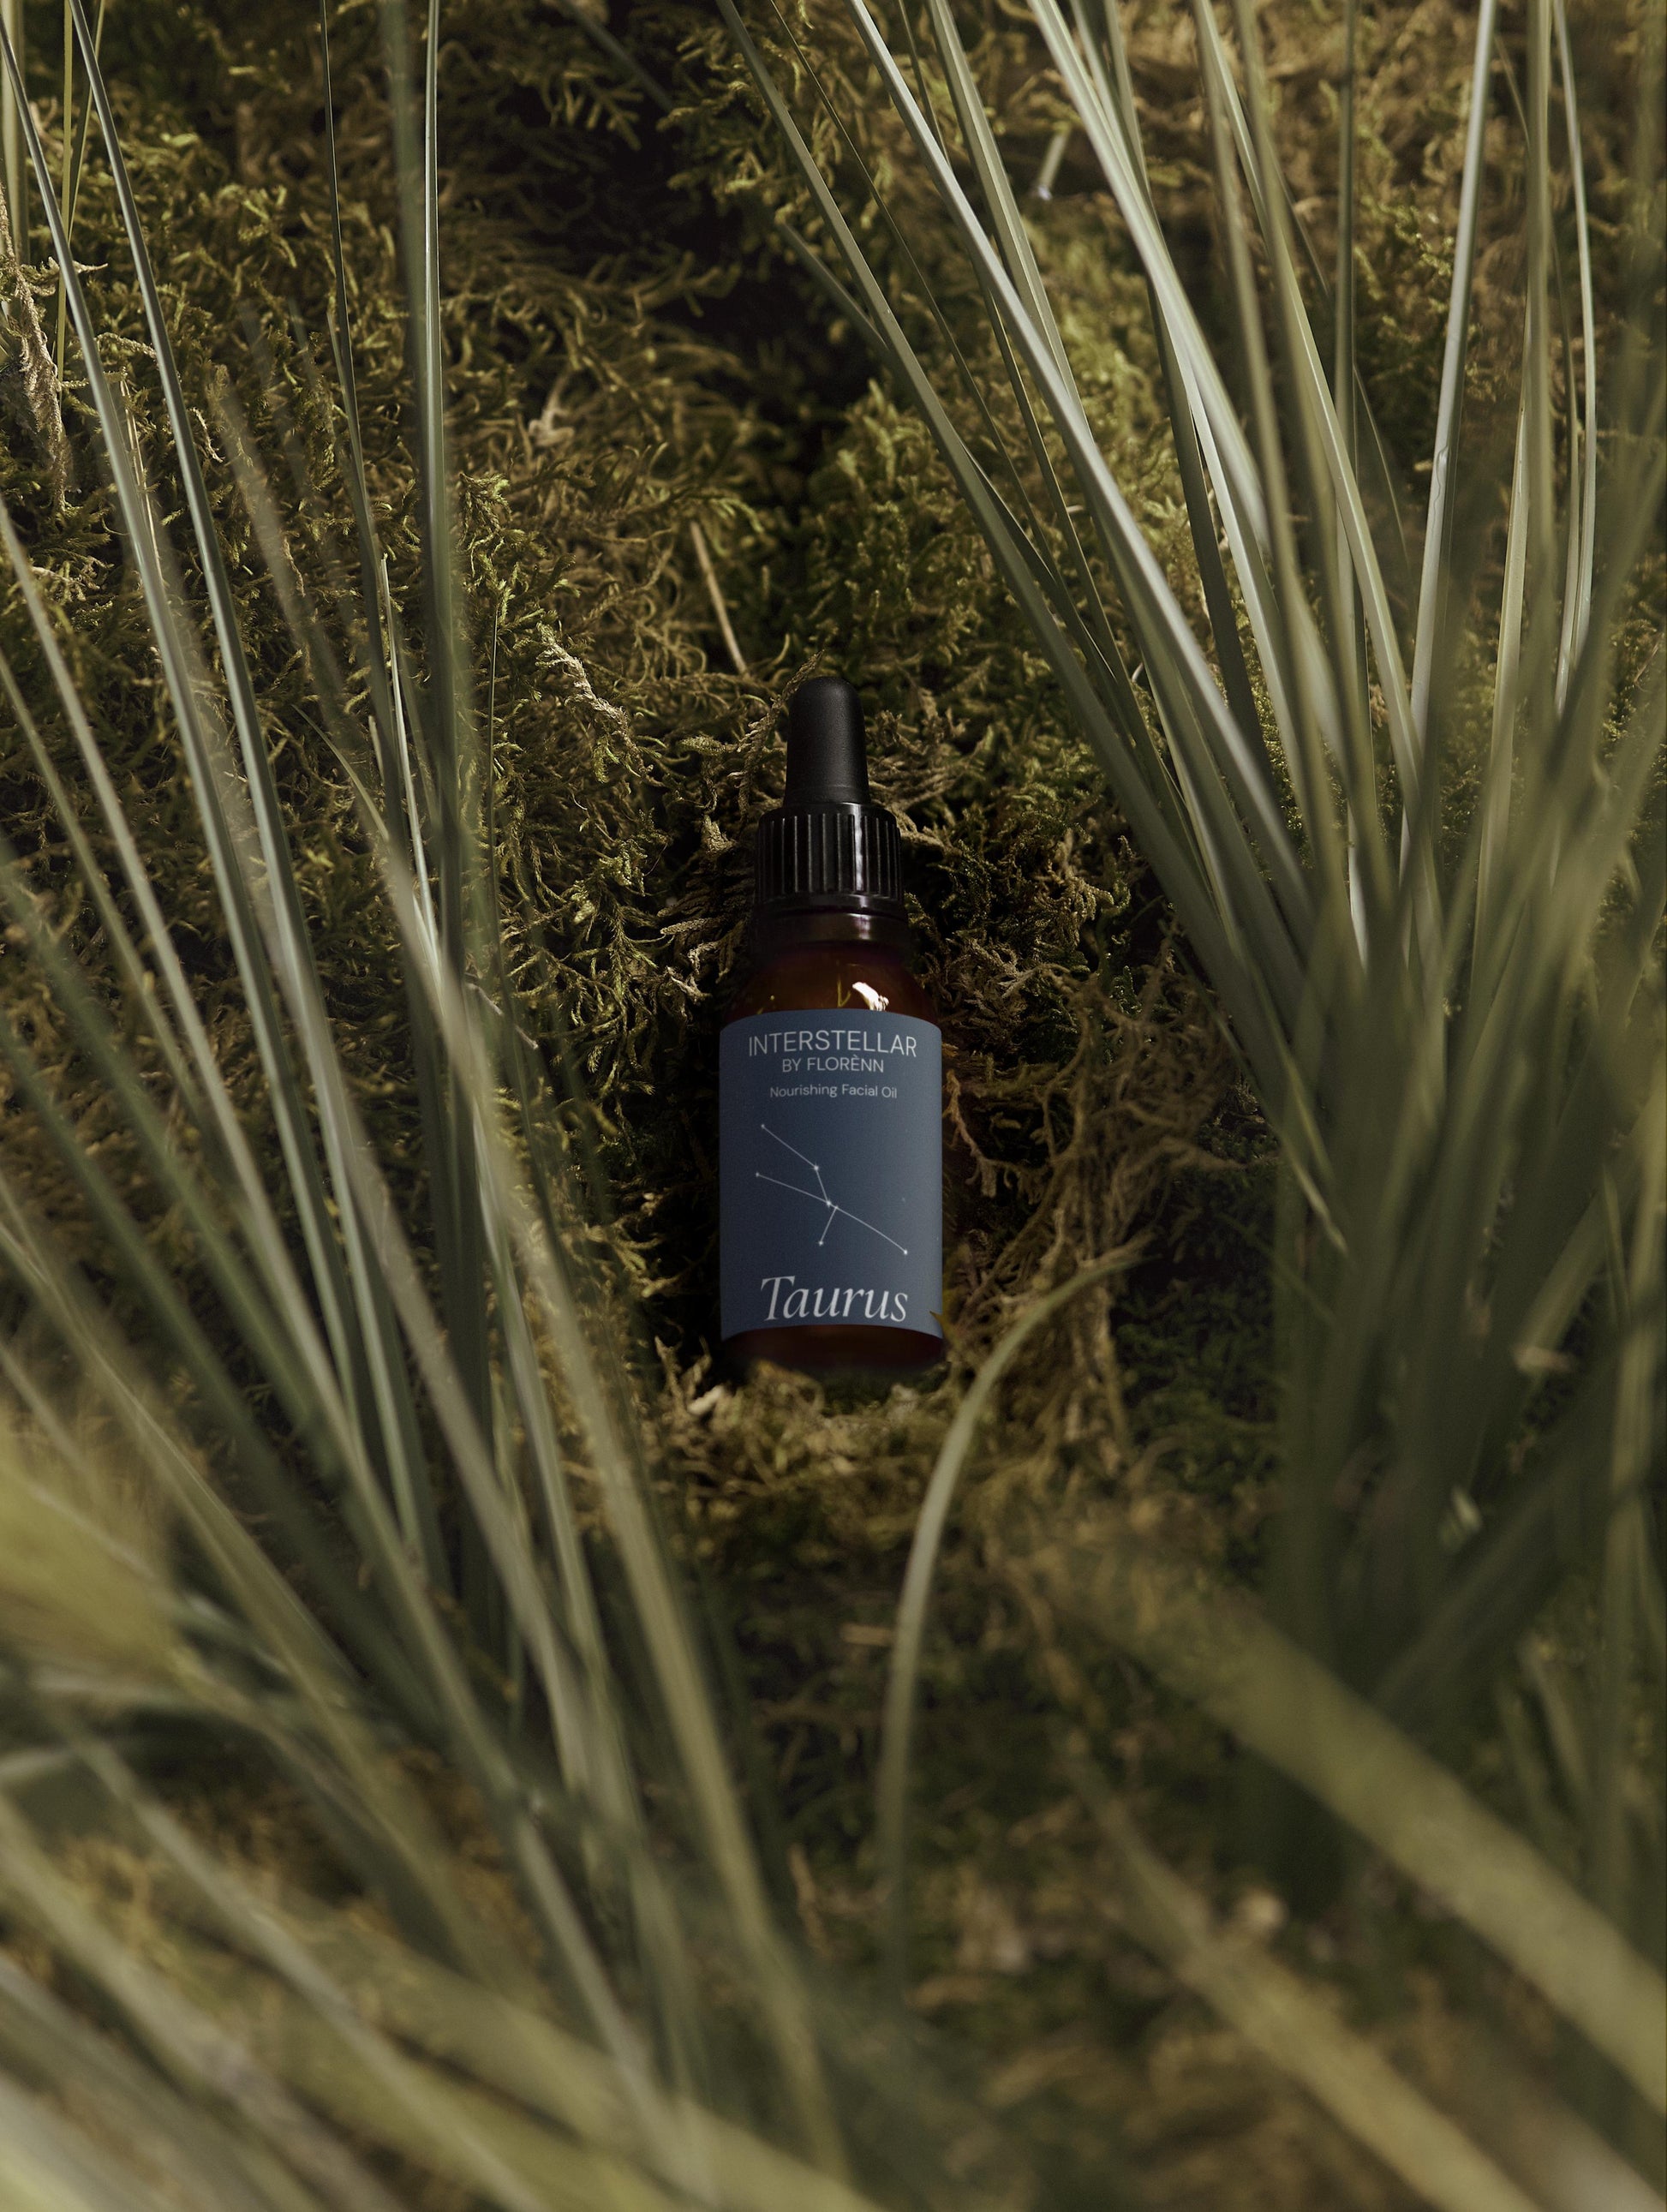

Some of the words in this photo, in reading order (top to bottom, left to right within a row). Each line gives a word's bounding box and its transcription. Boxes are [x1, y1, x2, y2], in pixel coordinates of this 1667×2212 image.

[749, 1030, 917, 1057] INTERSTELLAR
[782, 1058, 803, 1073] BY
[807, 1054, 884, 1073] FLORÈNN
[770, 1084, 838, 1098] Nourishing
[841, 1084, 878, 1097] Facial
[881, 1085, 898, 1099] Oil
[760, 1276, 908, 1322] Taurus
